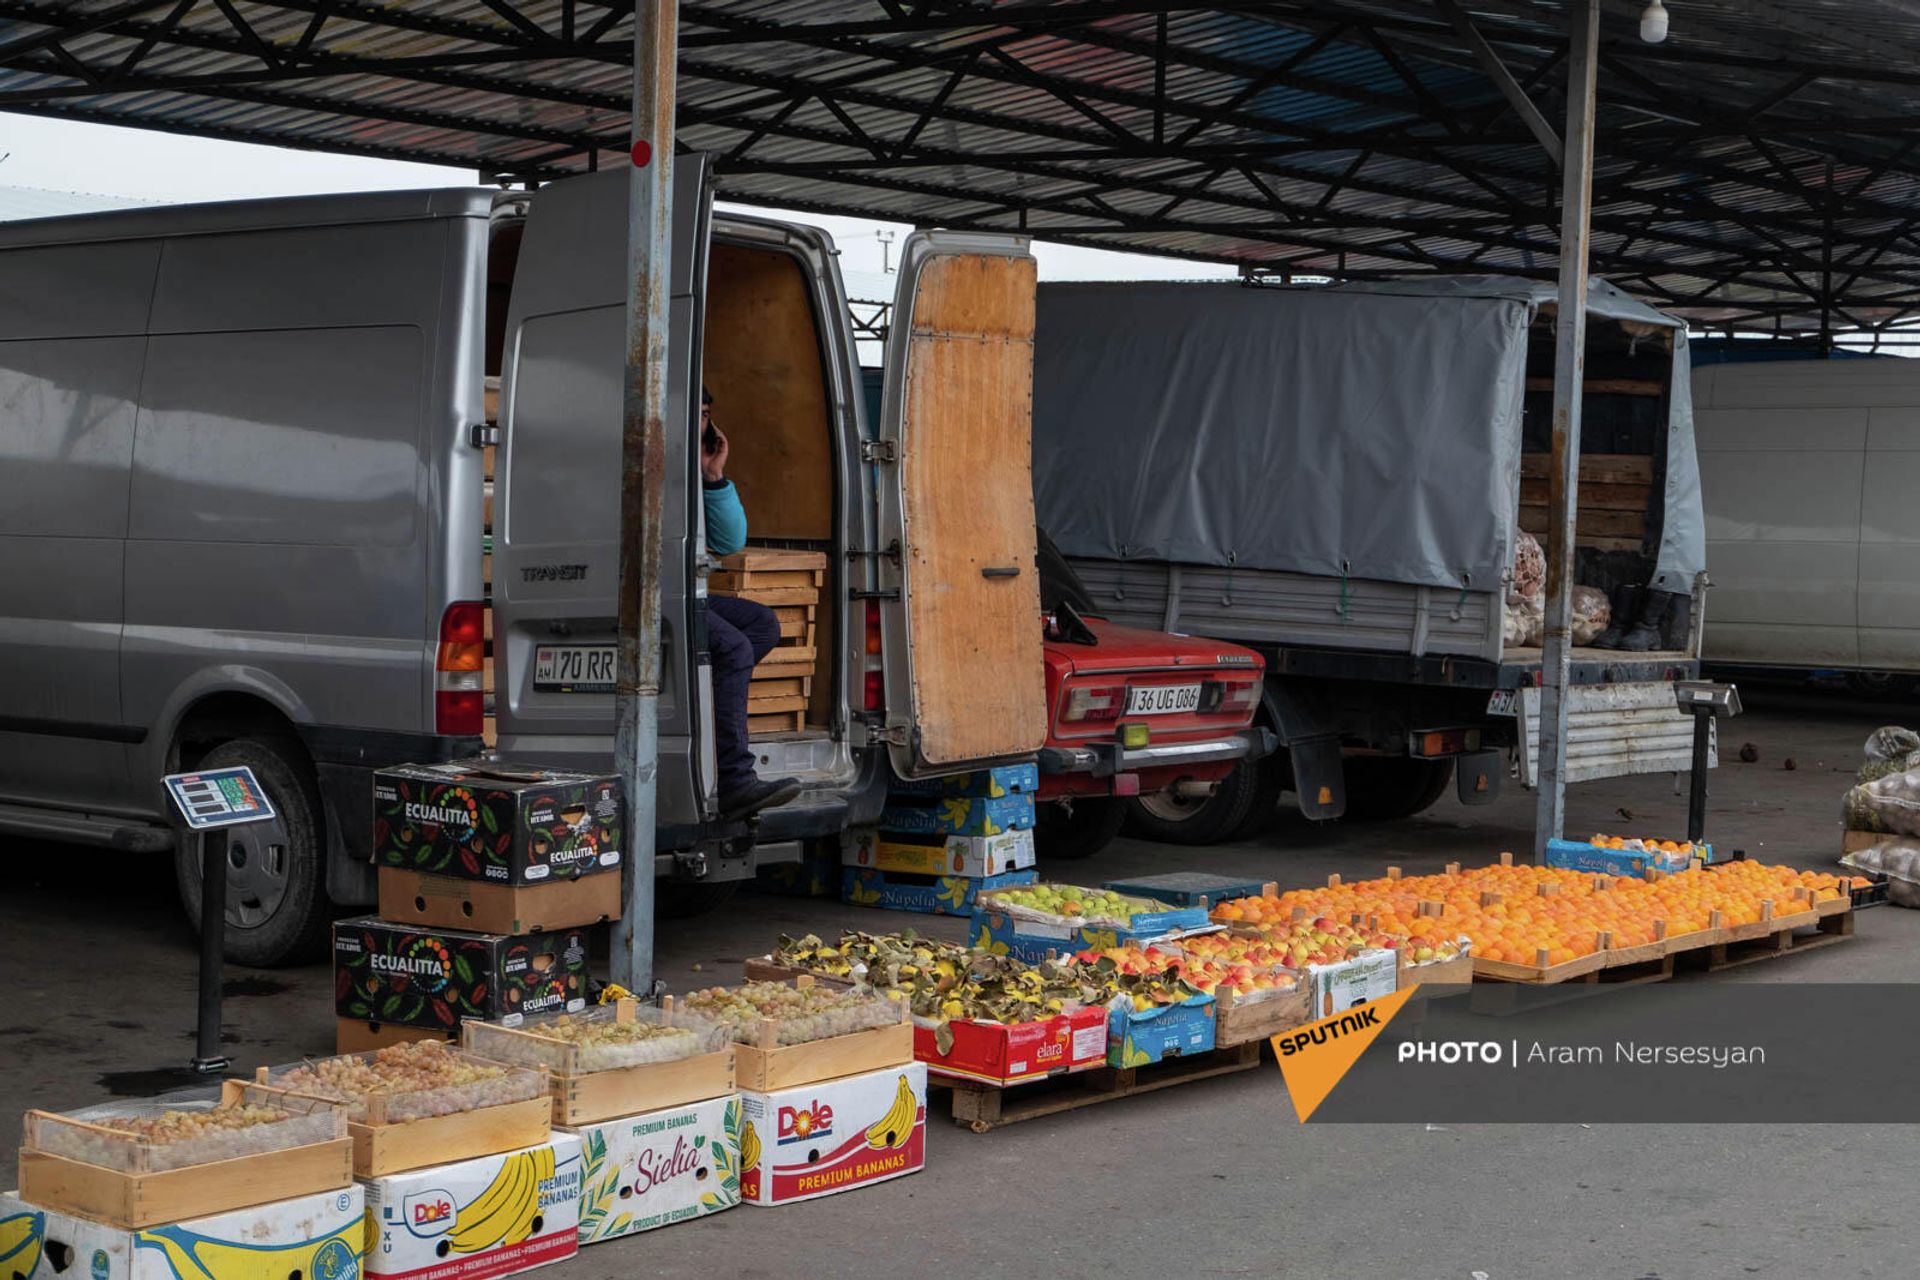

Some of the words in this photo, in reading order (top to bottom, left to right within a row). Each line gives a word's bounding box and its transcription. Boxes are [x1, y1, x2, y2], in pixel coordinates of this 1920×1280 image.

[520, 564, 589, 582] TRANSIT
[587, 651, 614, 680] RR
[1156, 689, 1175, 709] UG
[1176, 687, 1197, 708] 086
[405, 802, 471, 825] ECUALITTA
[550, 846, 593, 863] ECUALITTA
[370, 953, 443, 976] ECUALITTA
[523, 994, 561, 1011] ECUALITTA
[1037, 1042, 1062, 1058] elara
[633, 1121, 666, 1137] PREMIUM
[667, 1113, 698, 1131] BANANAS
[777, 1099, 833, 1138] Dole
[634, 1135, 700, 1195] Sielia
[799, 1168, 853, 1191] PREMIUM
[856, 1154, 905, 1177] BANANAS
[538, 1170, 578, 1192] PREMIUM
[414, 1199, 451, 1221] Dole
[537, 1189, 578, 1209] BANANAS
[633, 1213, 662, 1230] PRODUCT
[663, 1211, 671, 1223] OF
[671, 1205, 699, 1221] ECUADOR
[429, 1264, 460, 1280] BANANAS
[463, 1255, 493, 1271] PREMIUM
[494, 1249, 521, 1264] BANANAS
[524, 1240, 551, 1255] PREMIUM
